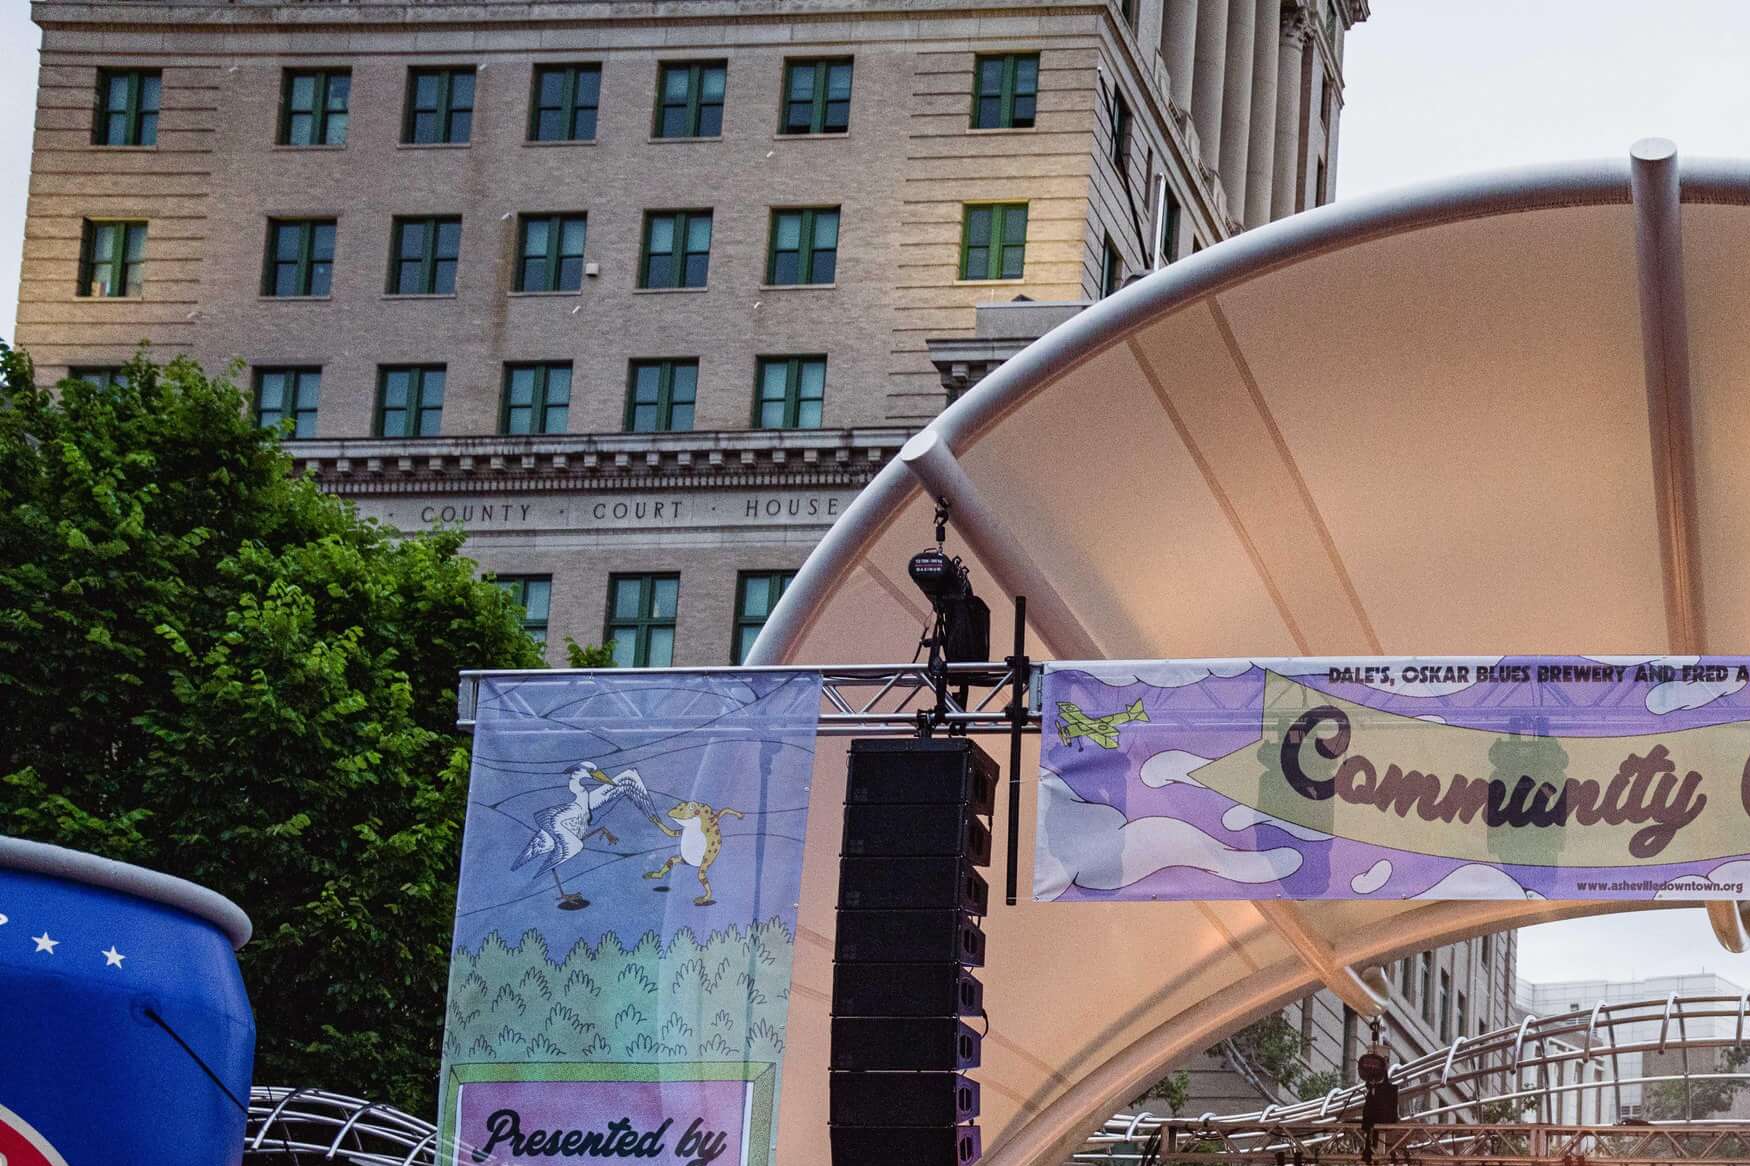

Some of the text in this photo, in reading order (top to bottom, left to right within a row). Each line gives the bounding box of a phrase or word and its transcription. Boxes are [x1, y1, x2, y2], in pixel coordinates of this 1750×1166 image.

[420, 498, 839, 523] COUNTY COURT HOUSE
[1328, 665, 1396, 687] DALE'S,
[1401, 665, 1470, 684] OSKAR
[1476, 665, 1531, 683] BLUES
[1537, 664, 1626, 683] BREWERY
[1635, 664, 1677, 683] AND
[1681, 664, 1729, 683] FRED
[1280, 704, 1707, 858] Community
[1576, 880, 1744, 893] www.ashevilledowntown.org
[471, 1109, 674, 1163] Presented
